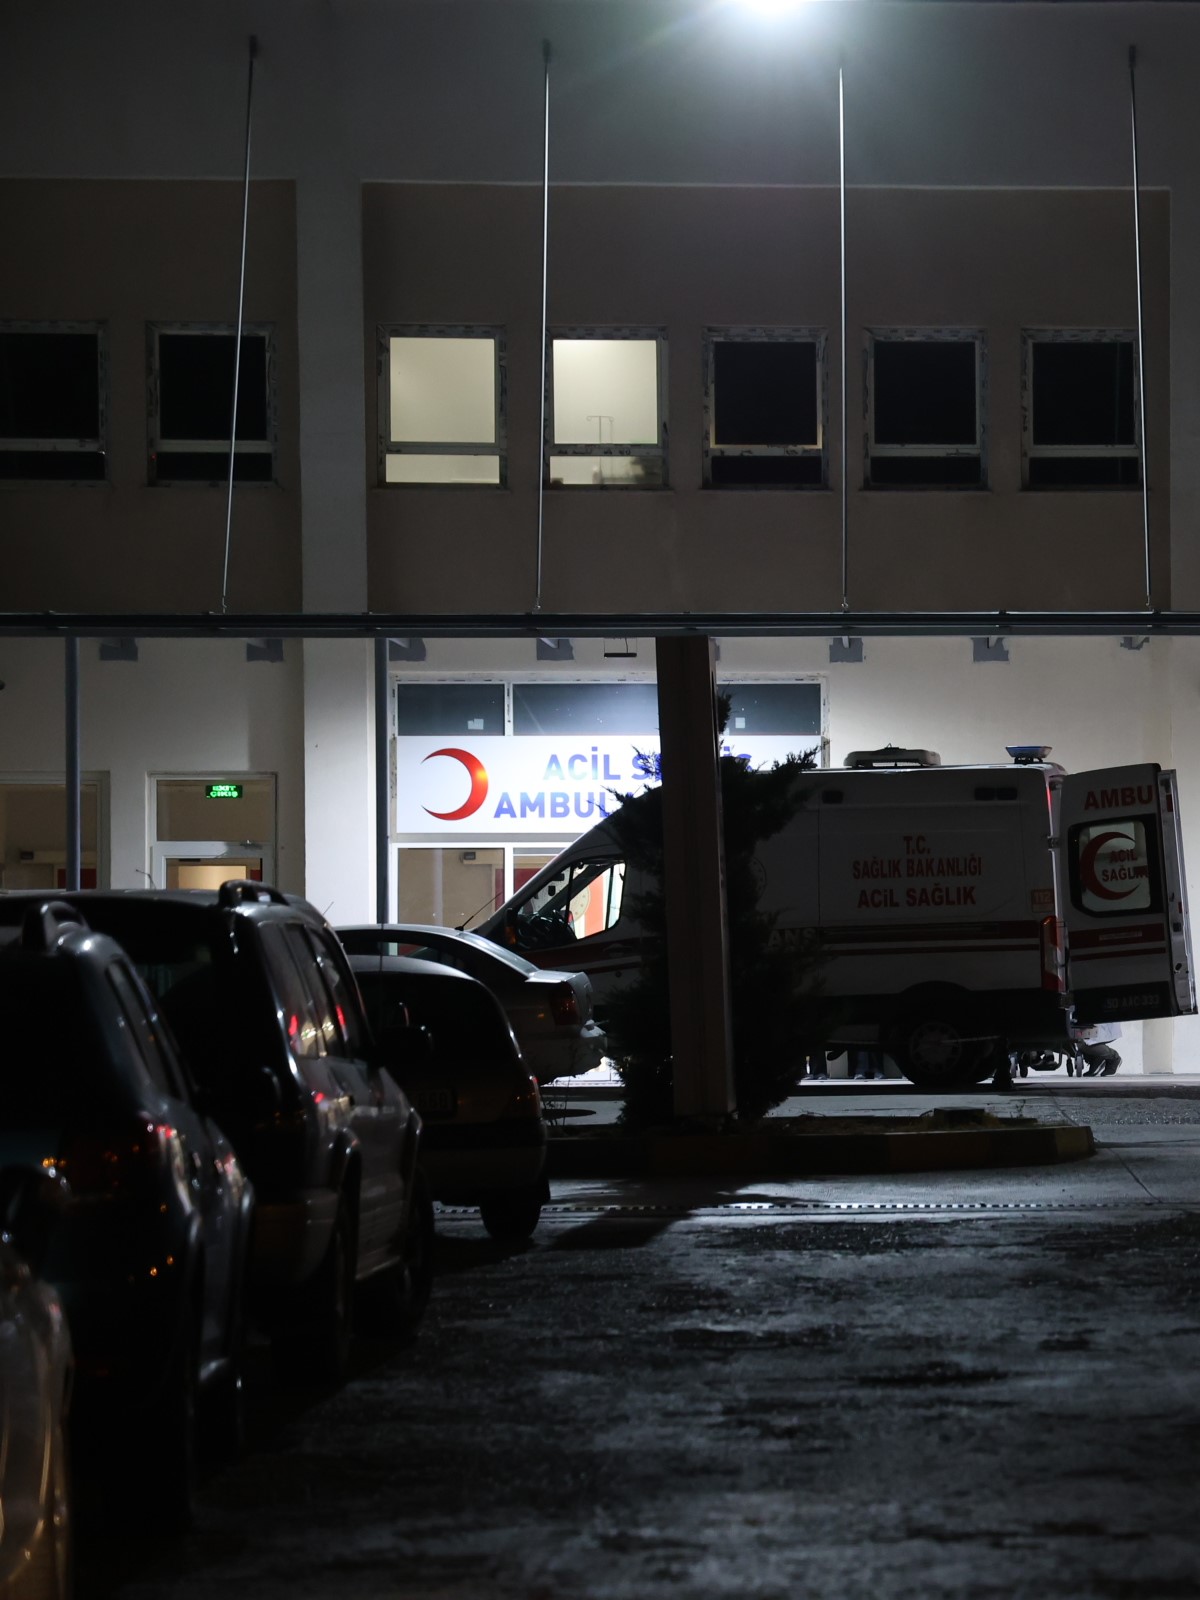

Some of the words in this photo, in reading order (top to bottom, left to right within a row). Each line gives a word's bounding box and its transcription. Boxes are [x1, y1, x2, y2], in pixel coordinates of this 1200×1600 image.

[543, 746, 621, 780] ACİL
[1084, 785, 1153, 810] AMBU
[903, 835, 931, 854] T.C.
[853, 856, 902, 880] SAĞLIK
[906, 853, 982, 877] BAKANLIĞI
[906, 883, 976, 907] SAĞLIK
